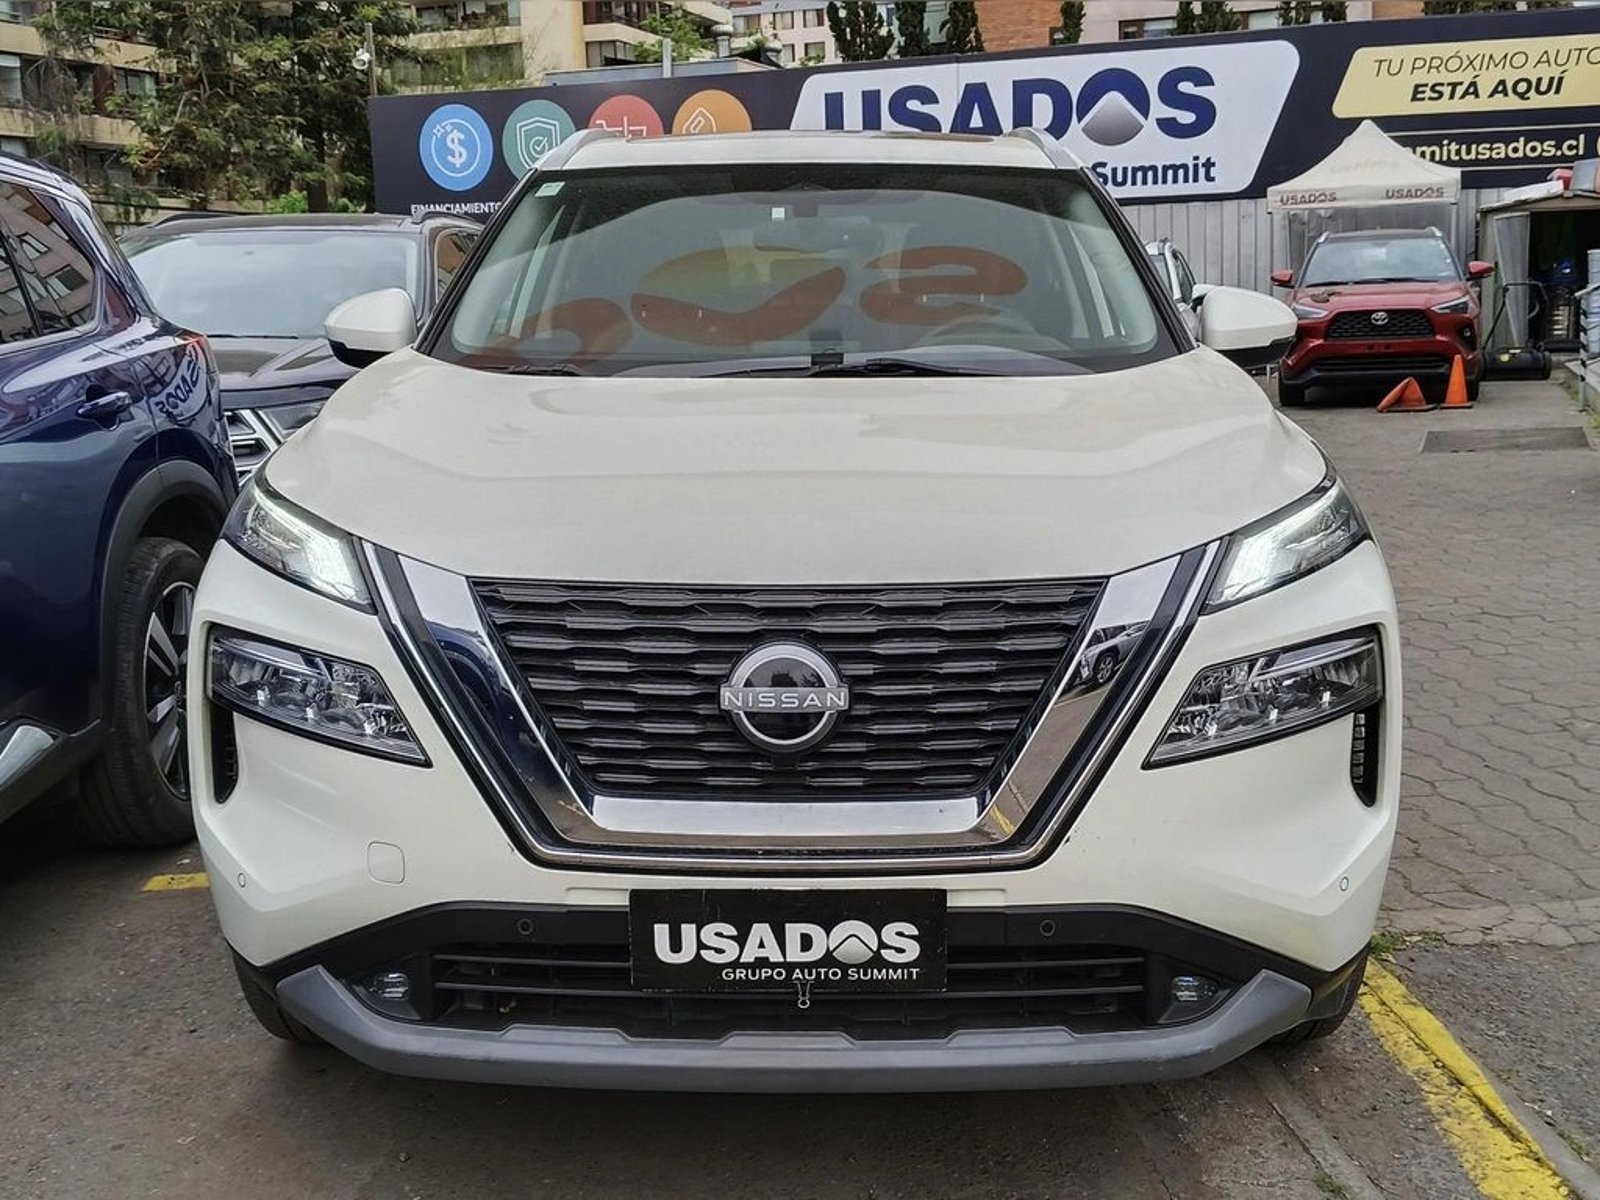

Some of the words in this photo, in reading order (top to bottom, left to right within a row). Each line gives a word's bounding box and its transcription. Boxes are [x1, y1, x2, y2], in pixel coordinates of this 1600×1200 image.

[1374, 58, 1404, 78] TU
[1410, 50, 1529, 75] PRÓXIMO
[1533, 46, 1600, 69] AUTO
[1410, 74, 1481, 102] ESTÁ
[1487, 69, 1569, 101] AQUÍ
[824, 66, 1217, 146] USADOS
[1091, 155, 1216, 188] Summit
[1385, 186, 1446, 200] USADOS
[724, 691, 846, 708] NISSAN
[653, 919, 922, 965] USADOS
[721, 967, 787, 981] GRUPO
[791, 967, 842, 981] AUTO
[847, 967, 921, 981] SUMMIT
